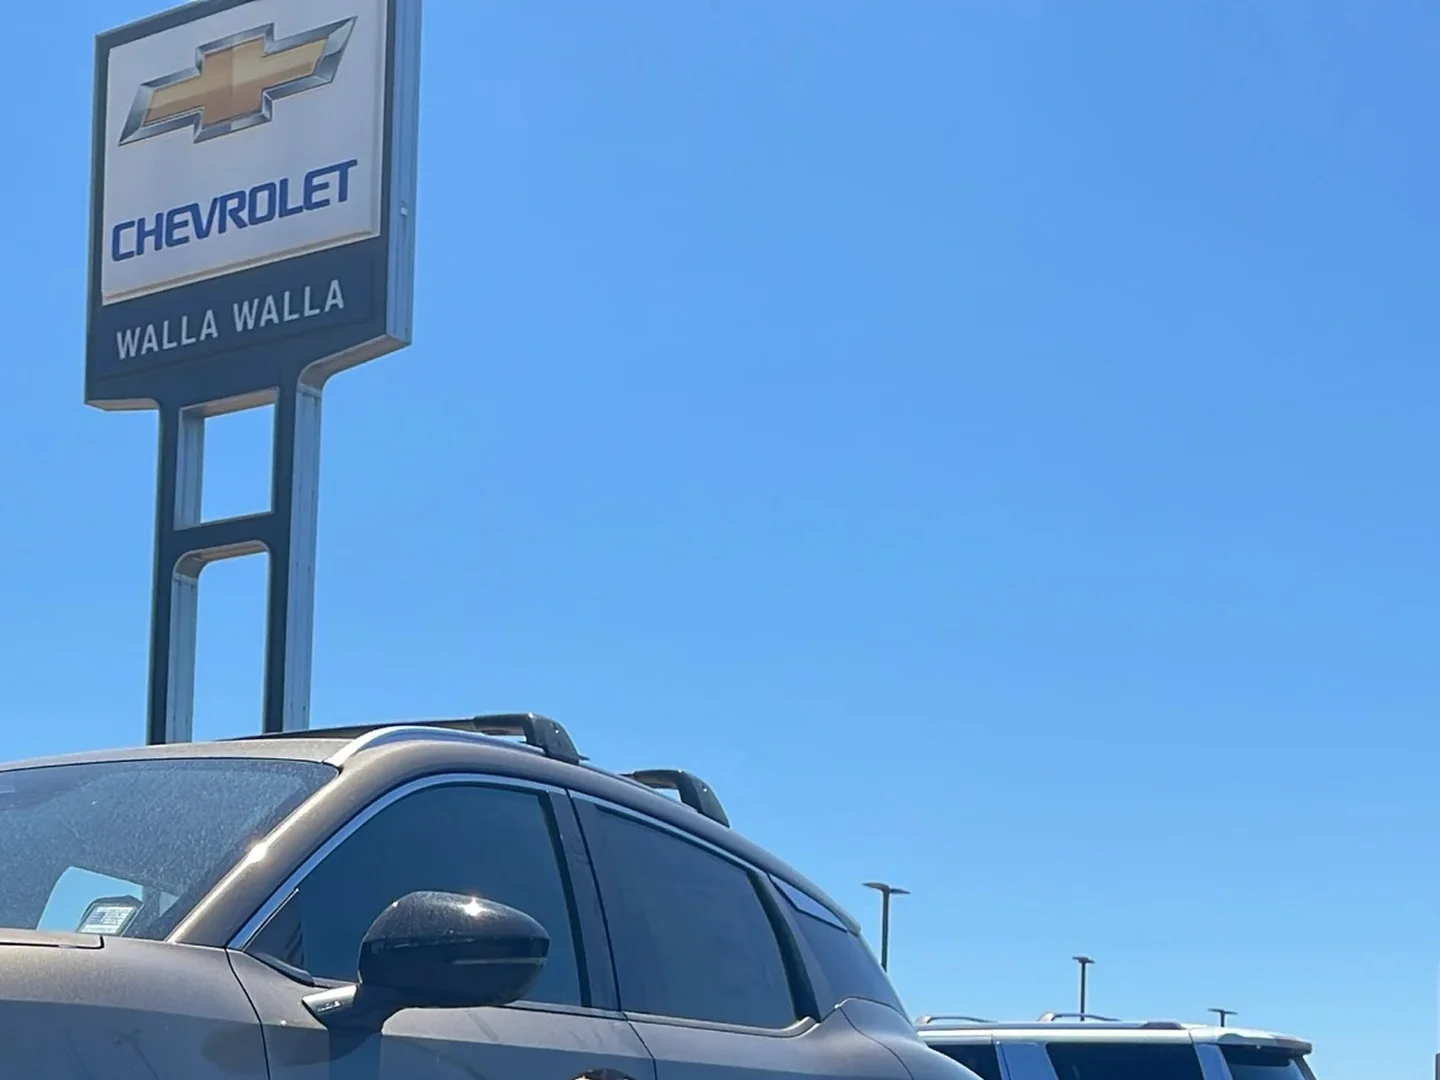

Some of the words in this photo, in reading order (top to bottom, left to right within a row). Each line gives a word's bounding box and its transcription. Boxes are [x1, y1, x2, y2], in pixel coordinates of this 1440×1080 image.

[112, 159, 358, 262] CHEVROLET
[116, 310, 219, 359] WALLA
[233, 279, 345, 332] WALLA
